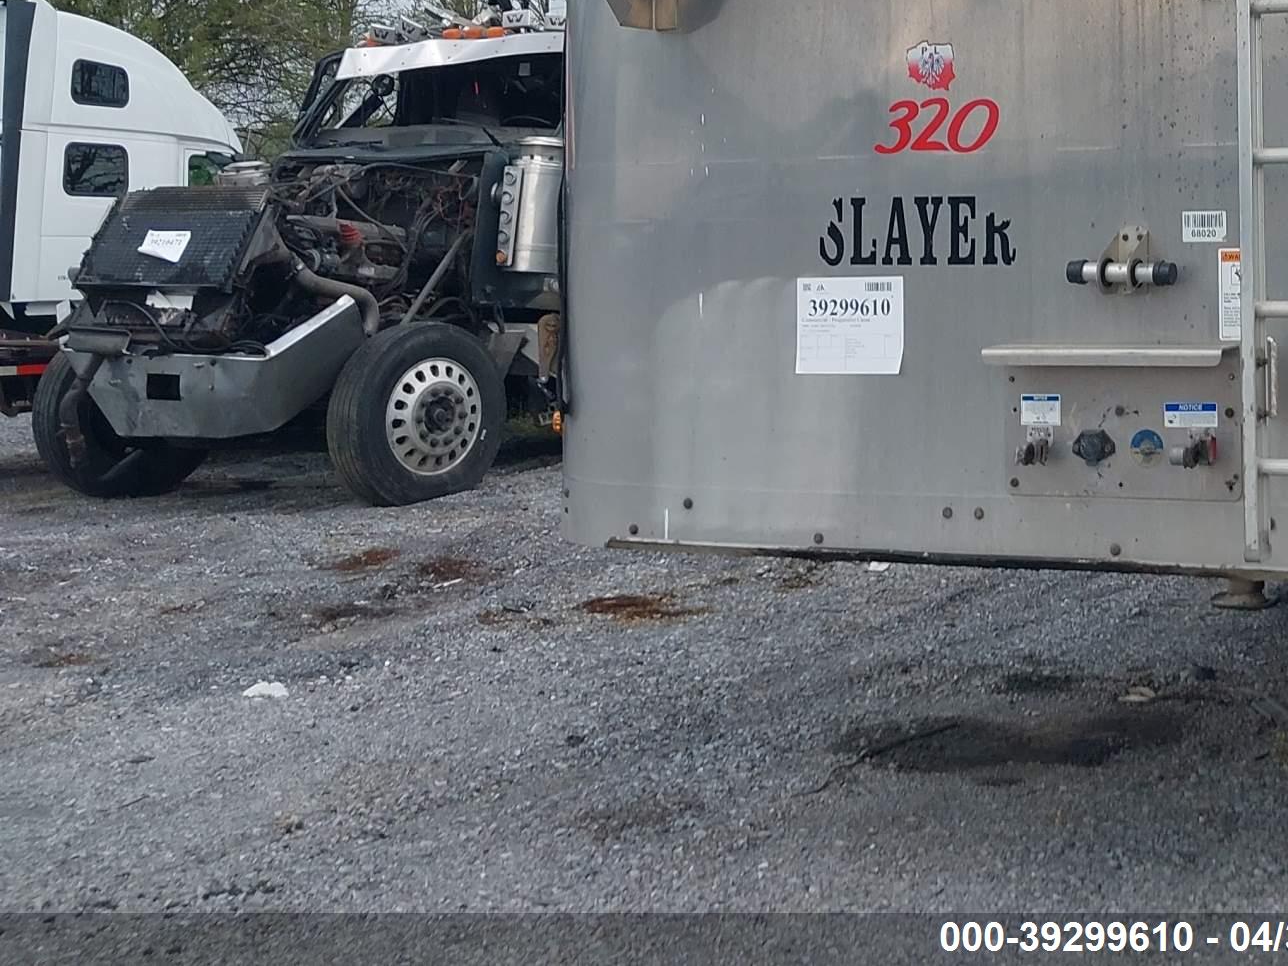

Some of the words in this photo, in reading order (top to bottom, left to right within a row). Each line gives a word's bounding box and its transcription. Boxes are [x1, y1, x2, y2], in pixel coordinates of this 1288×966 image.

[874, 97, 1000, 154] 320
[819, 196, 1017, 266] SLAYER
[808, 298, 891, 317] 39299610
